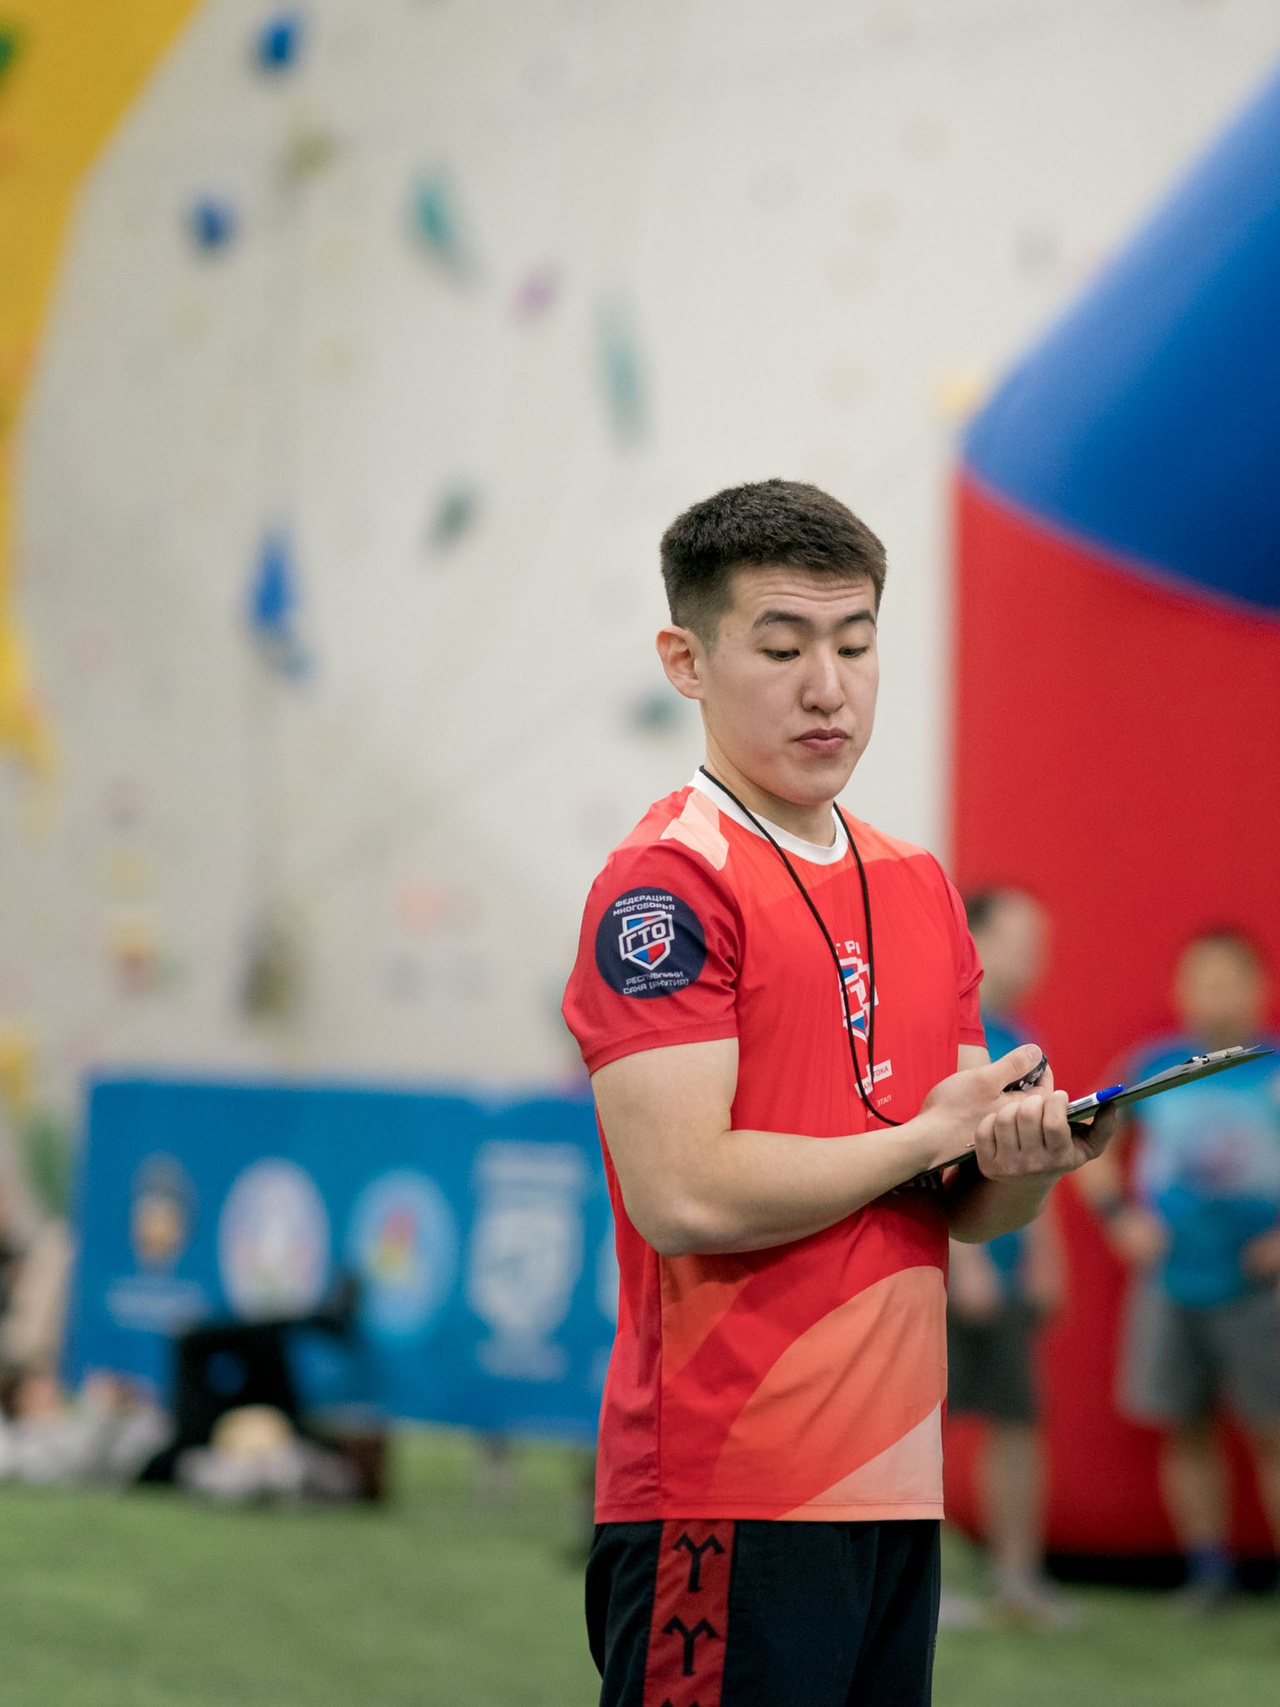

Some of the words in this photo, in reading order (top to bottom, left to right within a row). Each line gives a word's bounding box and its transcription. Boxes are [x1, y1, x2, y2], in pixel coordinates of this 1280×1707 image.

[615, 895, 673, 907] ФЕДЕРАЦИЯ
[613, 902, 675, 916] МНОГОБОРЬЯ
[626, 922, 667, 952] ГТО
[623, 983, 648, 994] САХА
